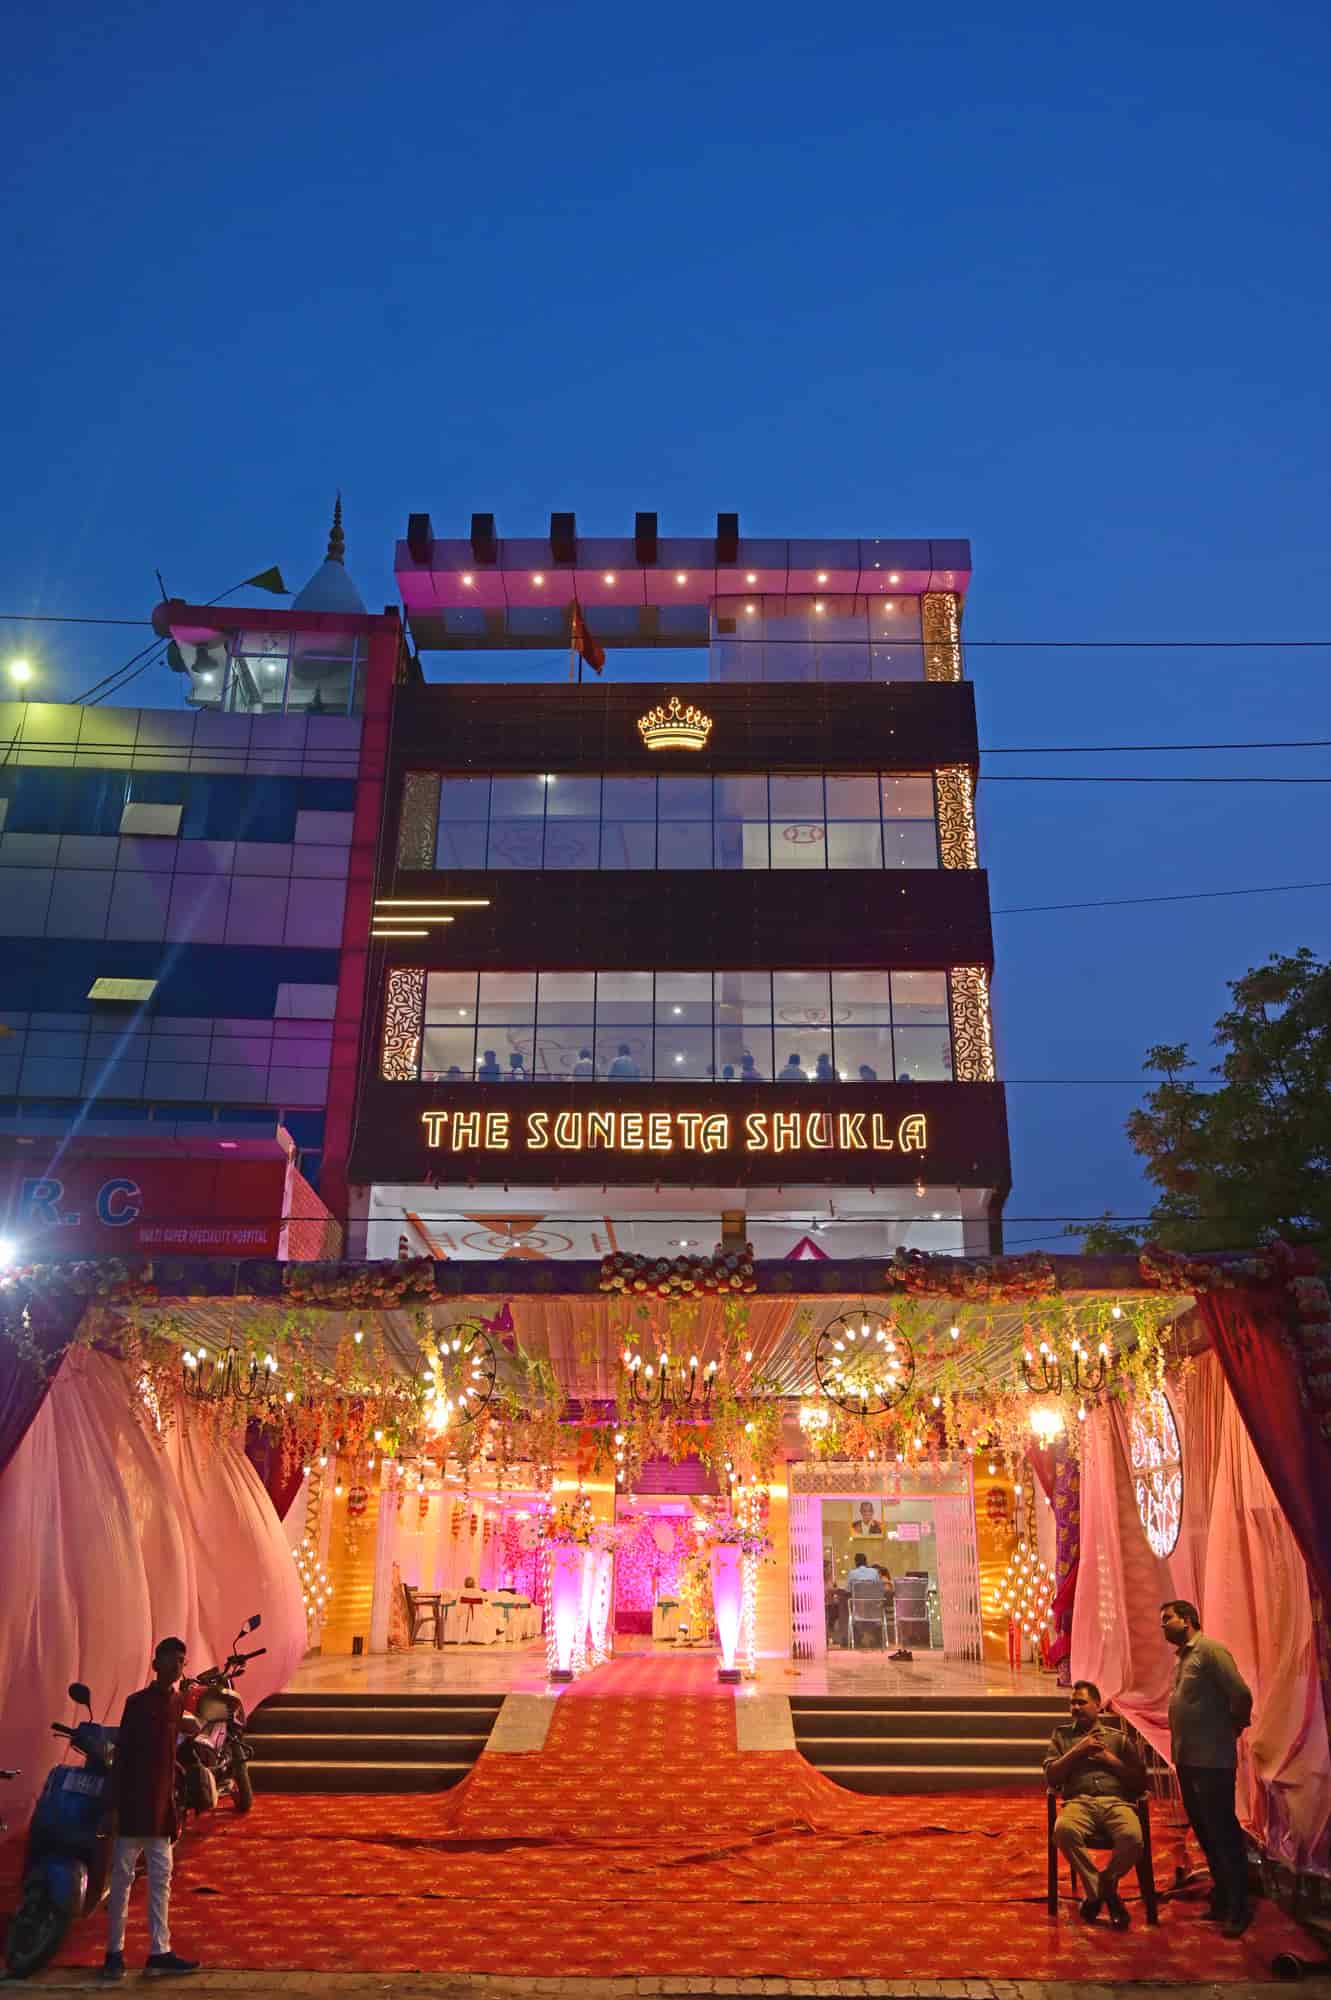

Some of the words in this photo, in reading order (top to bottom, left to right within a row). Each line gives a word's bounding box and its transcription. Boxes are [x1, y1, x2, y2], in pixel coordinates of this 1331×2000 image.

[422, 1112, 509, 1151] THE
[527, 1112, 728, 1152] SUNEETA
[746, 1113, 927, 1152] SHUKLA
